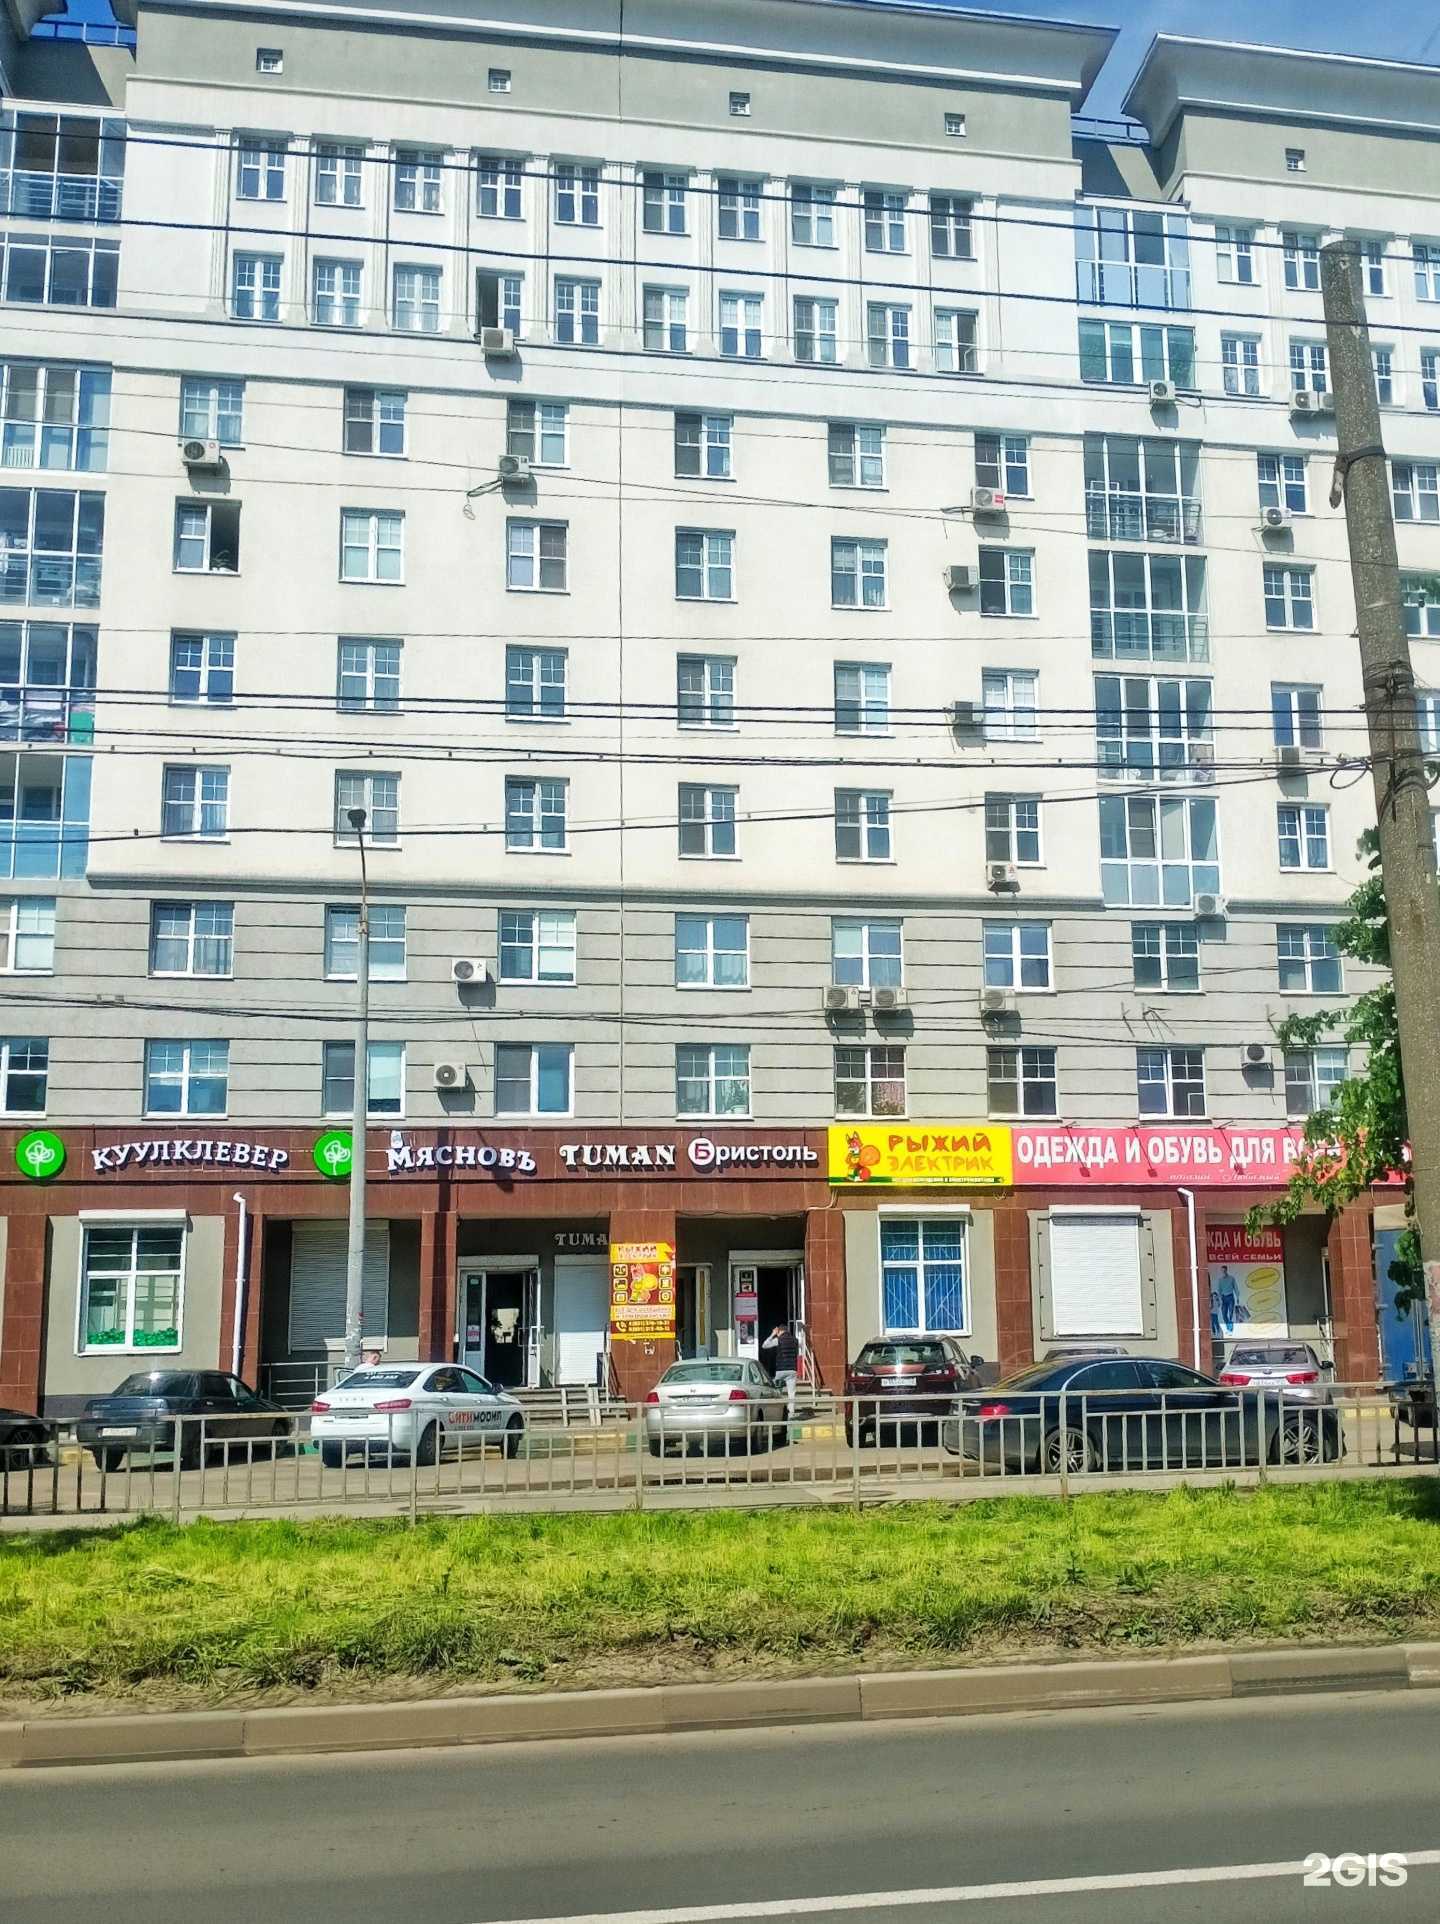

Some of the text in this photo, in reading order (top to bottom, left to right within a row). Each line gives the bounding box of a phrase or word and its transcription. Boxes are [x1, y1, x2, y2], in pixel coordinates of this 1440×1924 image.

[691, 1140, 818, 1166] Бристоль
[888, 1132, 992, 1153] РЫЖИЙ
[1017, 1135, 1119, 1168] ОДЕЖДА
[1124, 1136, 1141, 1163] И
[1147, 1136, 1223, 1164] ОБУВЬ
[1229, 1136, 1275, 1169] ДЛЯ
[91, 1140, 288, 1170] КУУЛКЛЕВЕР
[386, 1146, 537, 1172] МЯСНОВЪ
[559, 1144, 676, 1166] TUMAN
[887, 1155, 994, 1172] ЭЛЕКТРИК
[1233, 1231, 1241, 1248] И
[1245, 1231, 1281, 1248] ОБУВЬ
[1209, 1251, 1282, 1261] ВСЕЙ СЕМЬИ
